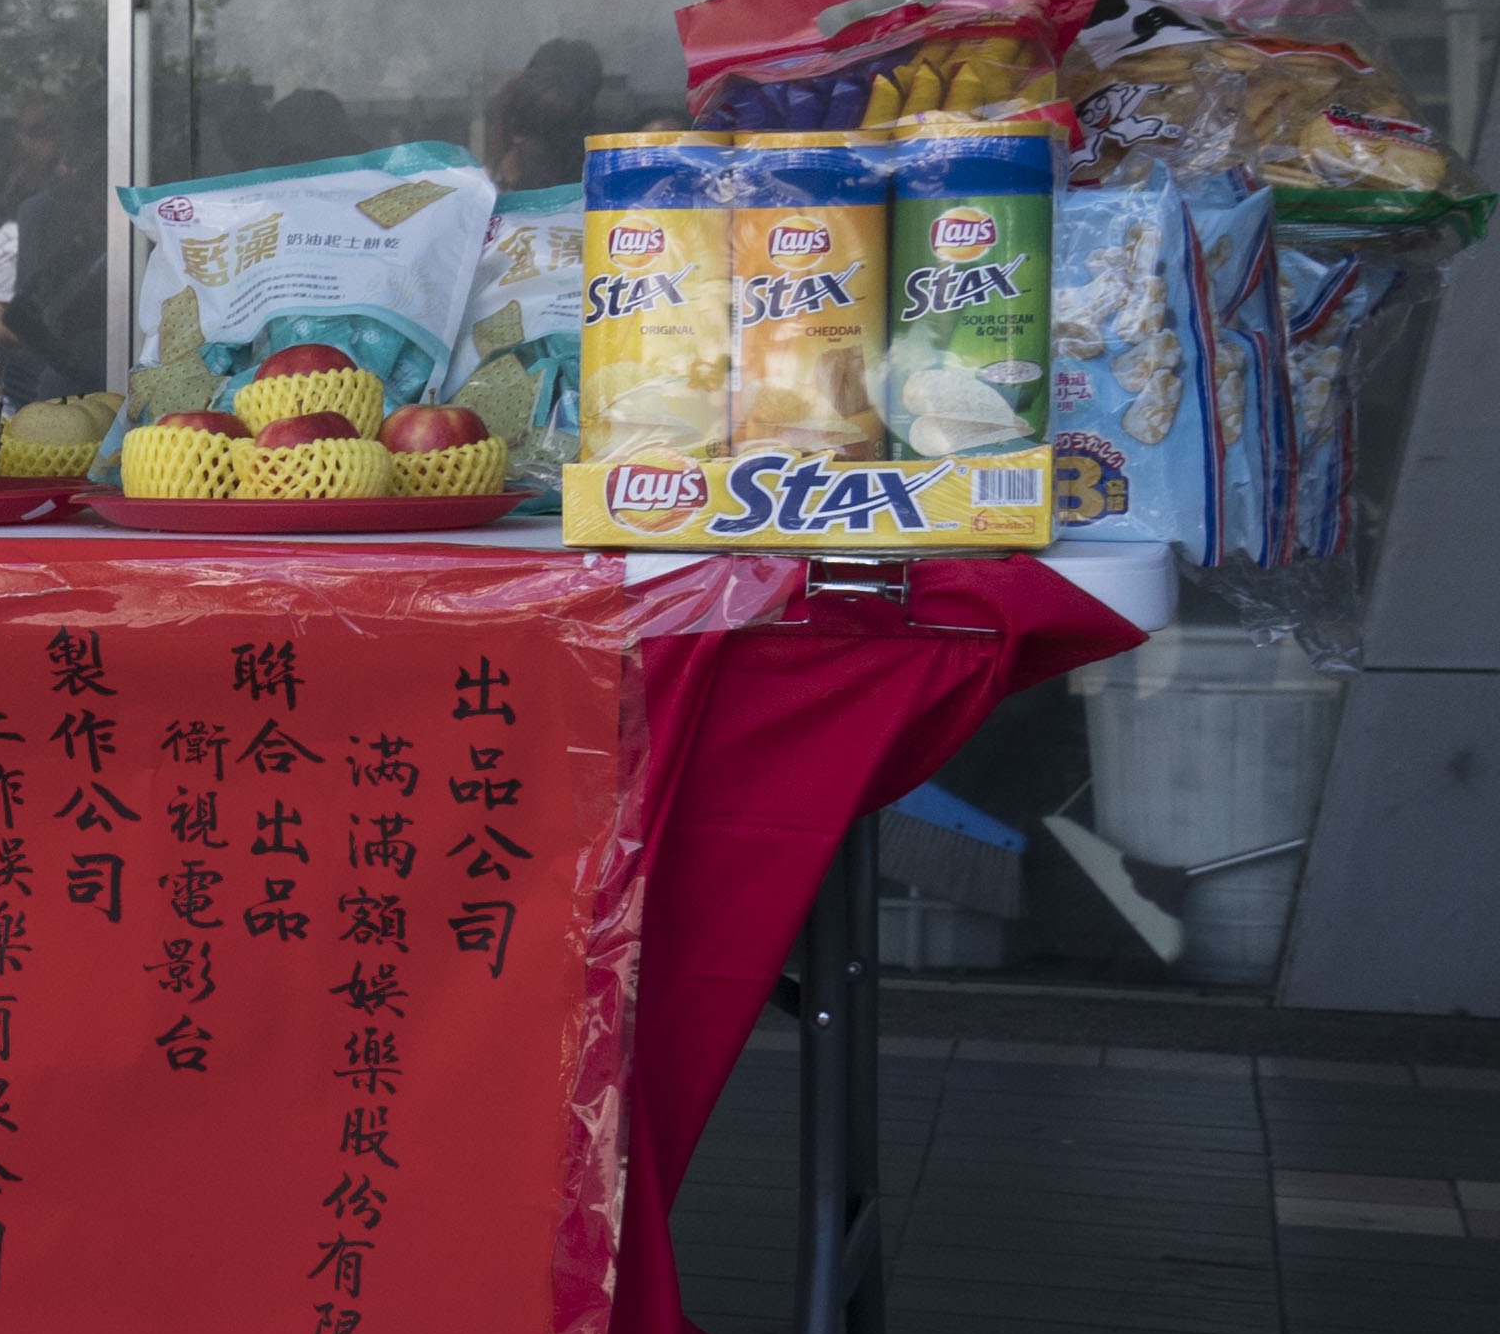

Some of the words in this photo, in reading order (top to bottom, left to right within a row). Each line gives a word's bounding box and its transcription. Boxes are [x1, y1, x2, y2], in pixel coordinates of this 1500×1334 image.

[285, 232, 402, 251] 奶油起士餅乾
[610, 227, 664, 256] Lay's
[770, 227, 829, 256] Lay's
[934, 218, 994, 248] Lay's
[639, 325, 696, 336] ORIGINAL
[805, 325, 862, 338] CHEDDAR
[963, 315, 995, 326] SOUR
[997, 314, 1034, 325] CREAM
[987, 325, 1024, 336] ONION
[610, 465, 705, 510] Lay's
[44, 625, 142, 924] 製作公司
[230, 640, 325, 943] 聯合出品
[446, 655, 534, 980] 出品公司
